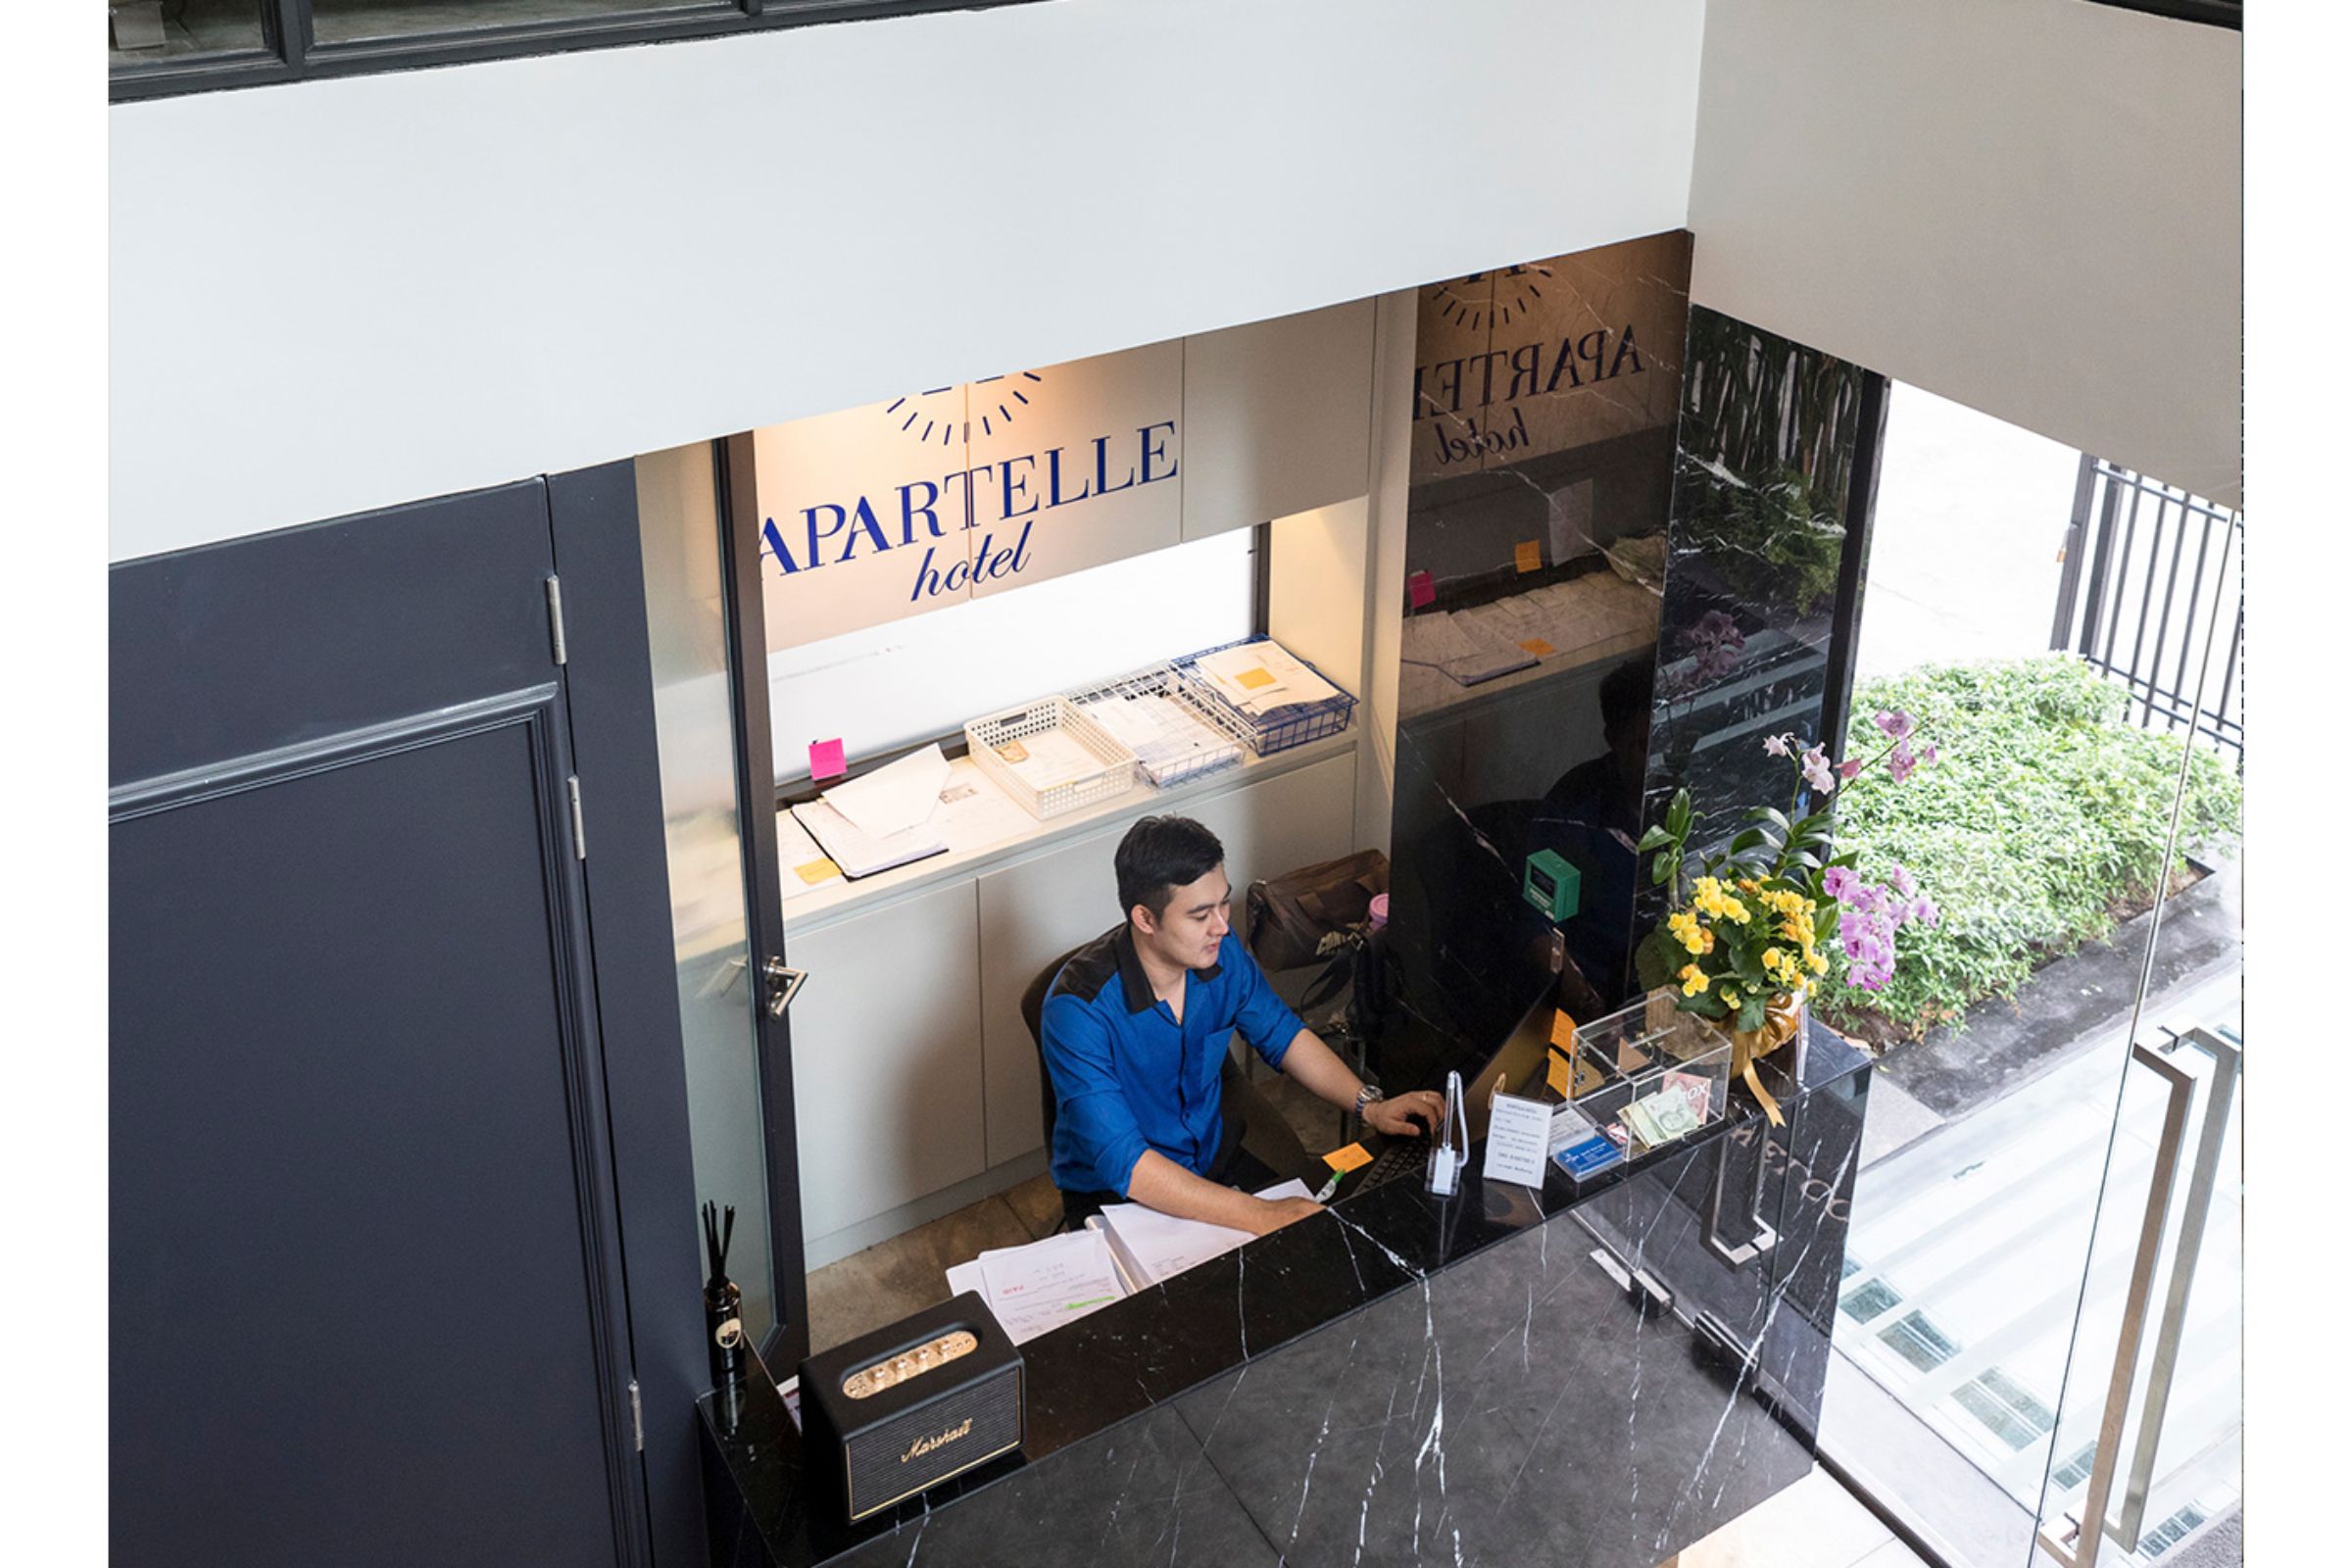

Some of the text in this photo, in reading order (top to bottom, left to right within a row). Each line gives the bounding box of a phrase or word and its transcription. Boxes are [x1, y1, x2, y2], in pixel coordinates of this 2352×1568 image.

[760, 420, 1178, 576] APARTELLE
[910, 521, 1033, 602] hotel
[900, 1417, 973, 1463] Marshall
